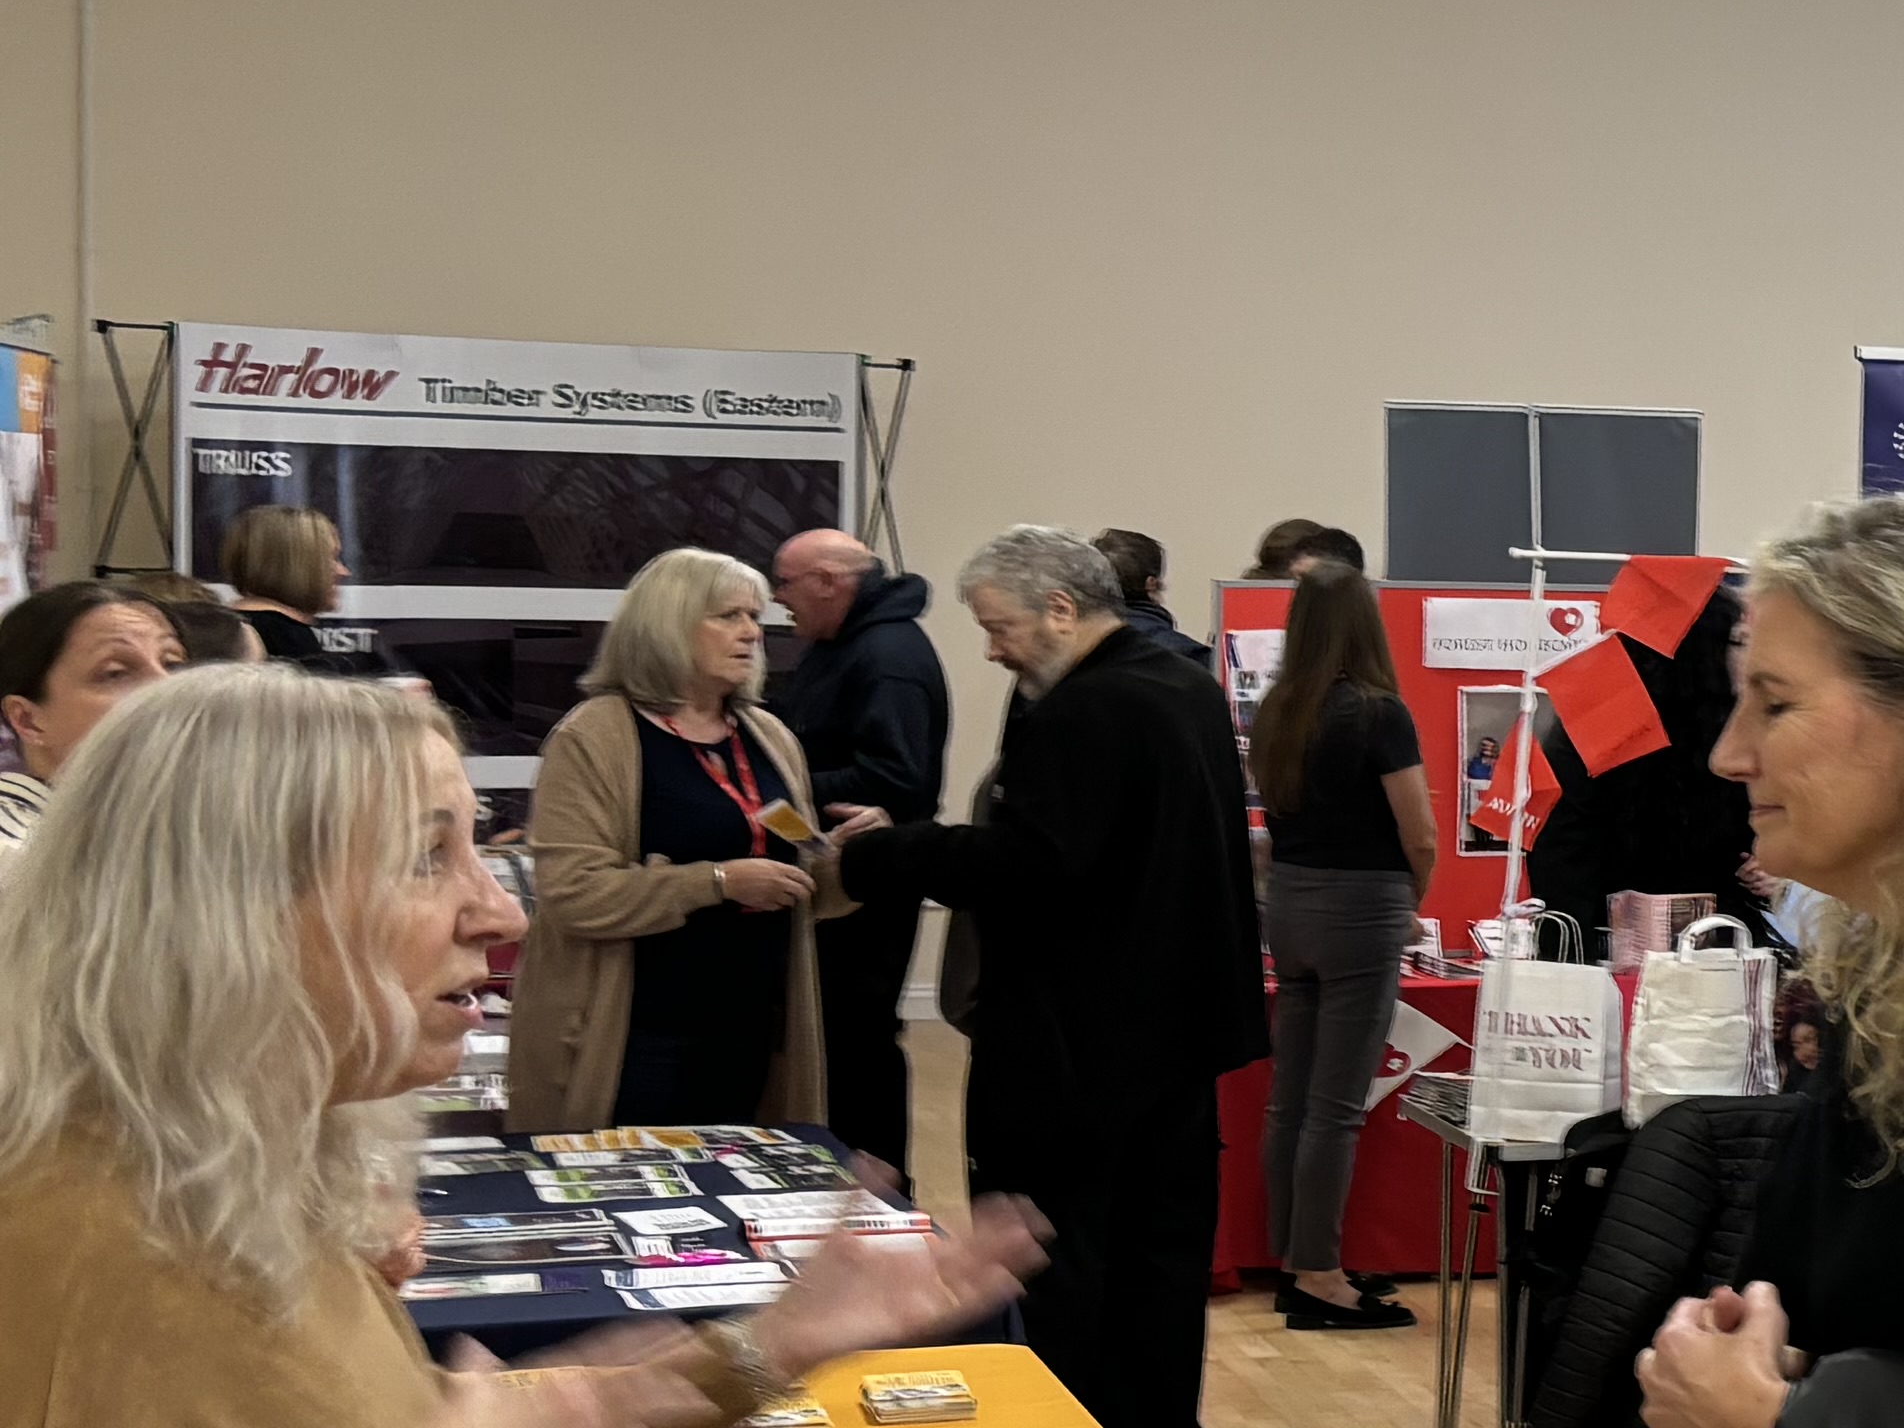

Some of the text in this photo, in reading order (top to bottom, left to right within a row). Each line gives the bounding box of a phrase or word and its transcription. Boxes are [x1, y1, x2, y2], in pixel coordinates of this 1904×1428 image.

[194, 340, 843, 424] Harlow Timber Systems (Eastern)
[191, 446, 294, 478] TRUSS
